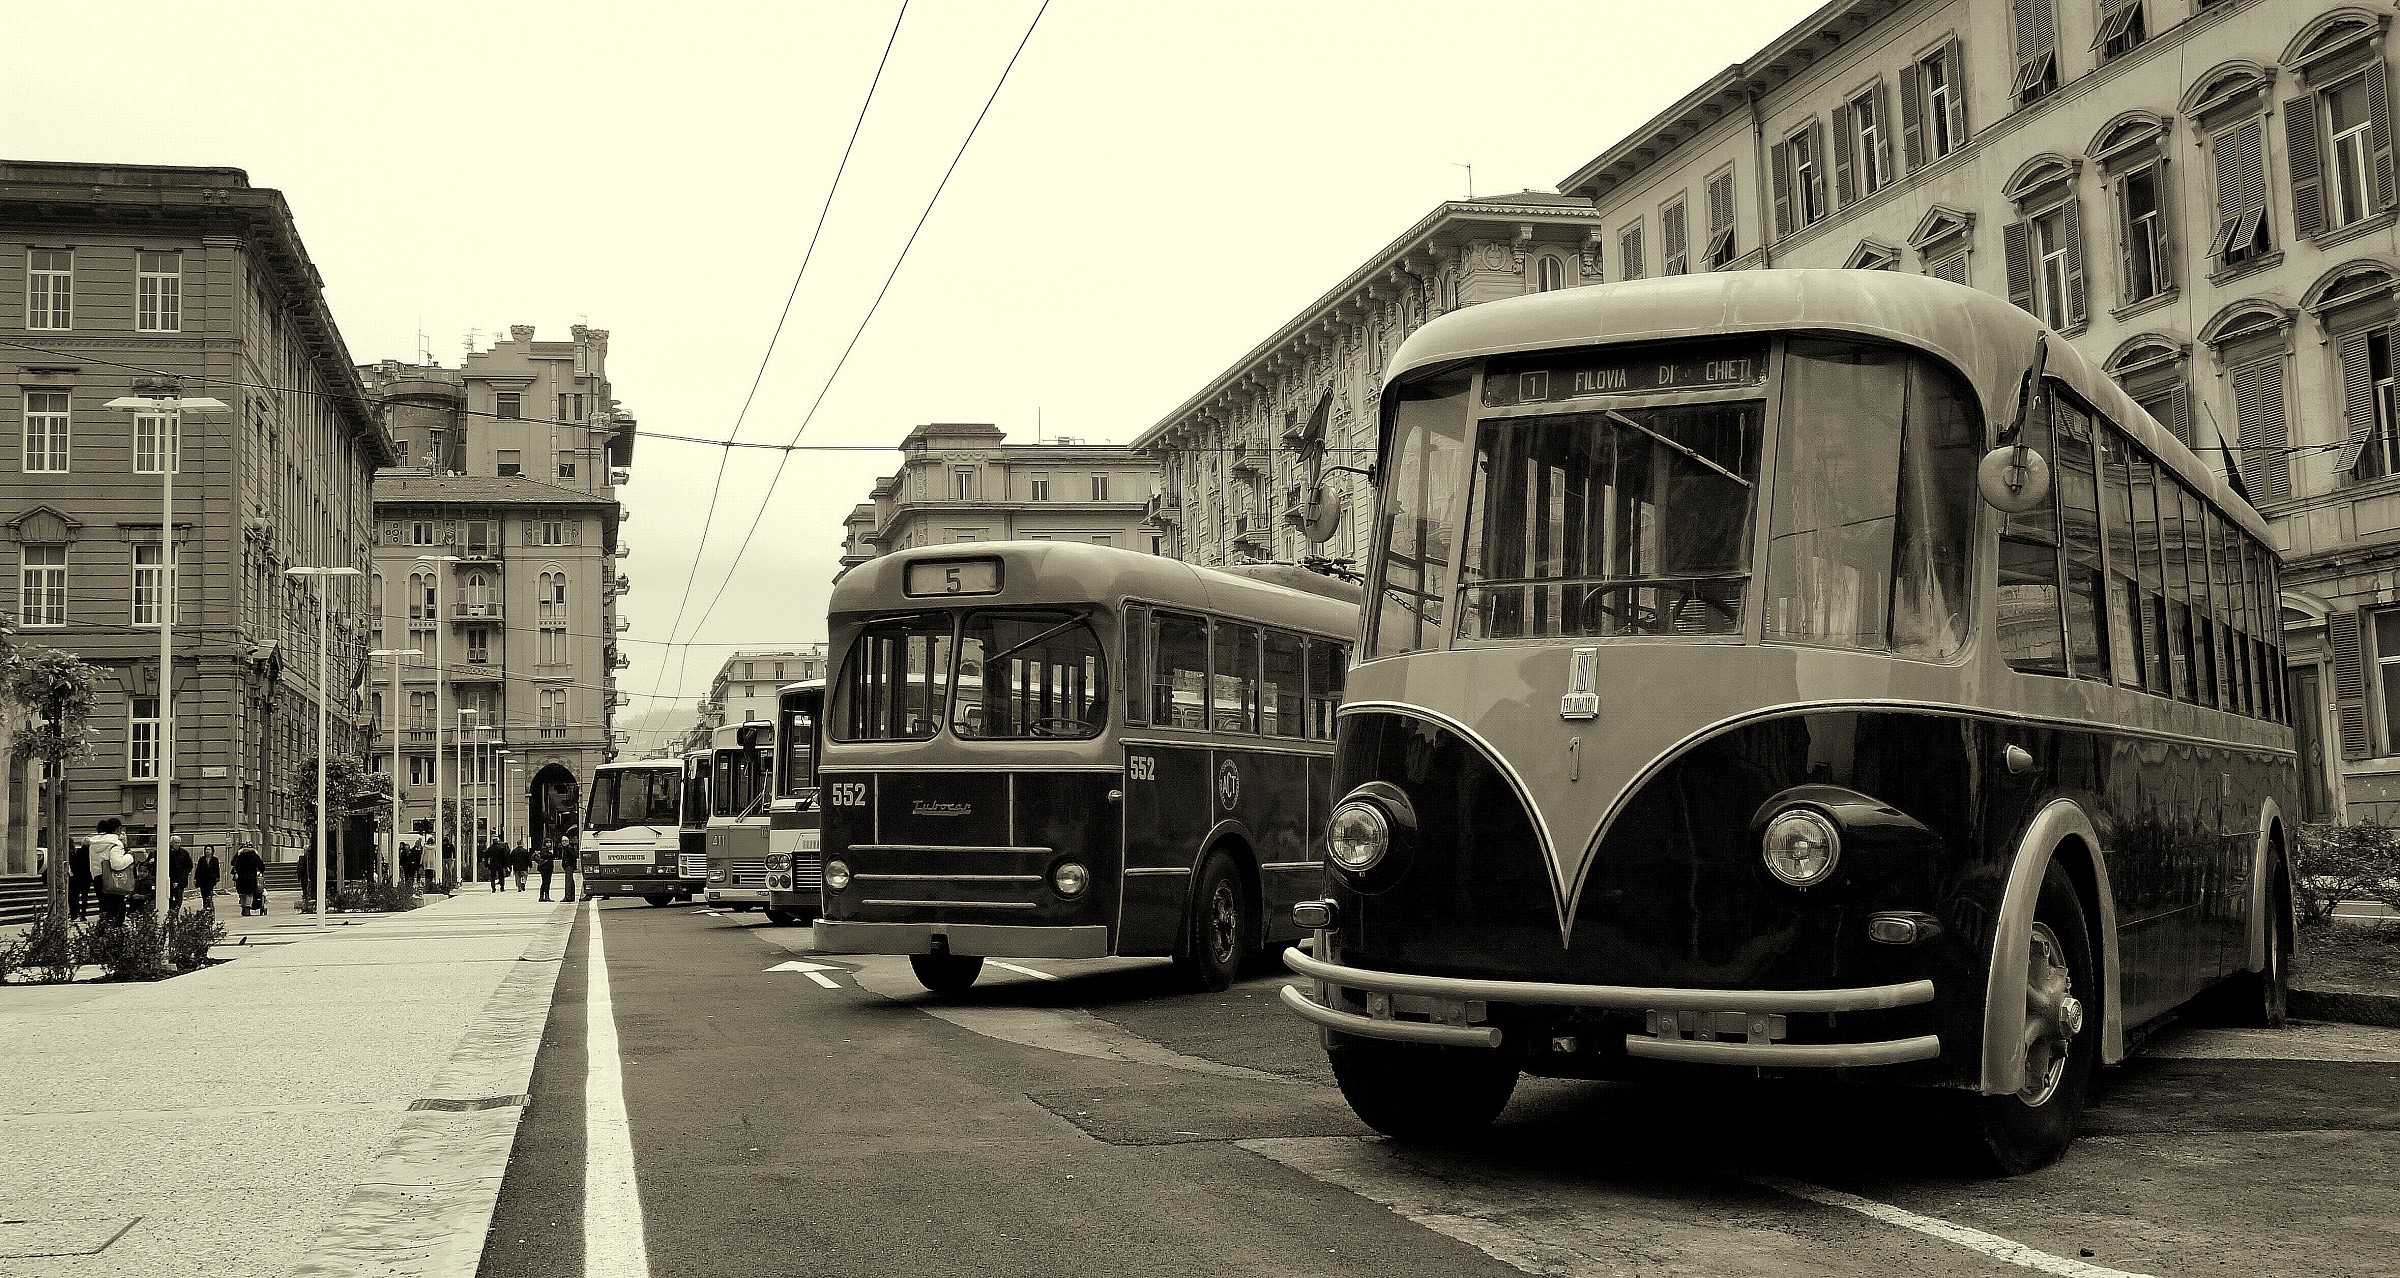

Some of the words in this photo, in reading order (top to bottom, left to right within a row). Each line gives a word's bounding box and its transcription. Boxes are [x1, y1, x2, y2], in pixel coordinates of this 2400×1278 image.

[1530, 376, 1537, 395] 1
[1575, 368, 1627, 391] FILOVIA
[1658, 365, 1674, 385] DI
[1705, 359, 1751, 381] CHIETI
[945, 568, 961, 593] 5
[1130, 755, 1155, 780] 552
[832, 783, 866, 806] 552
